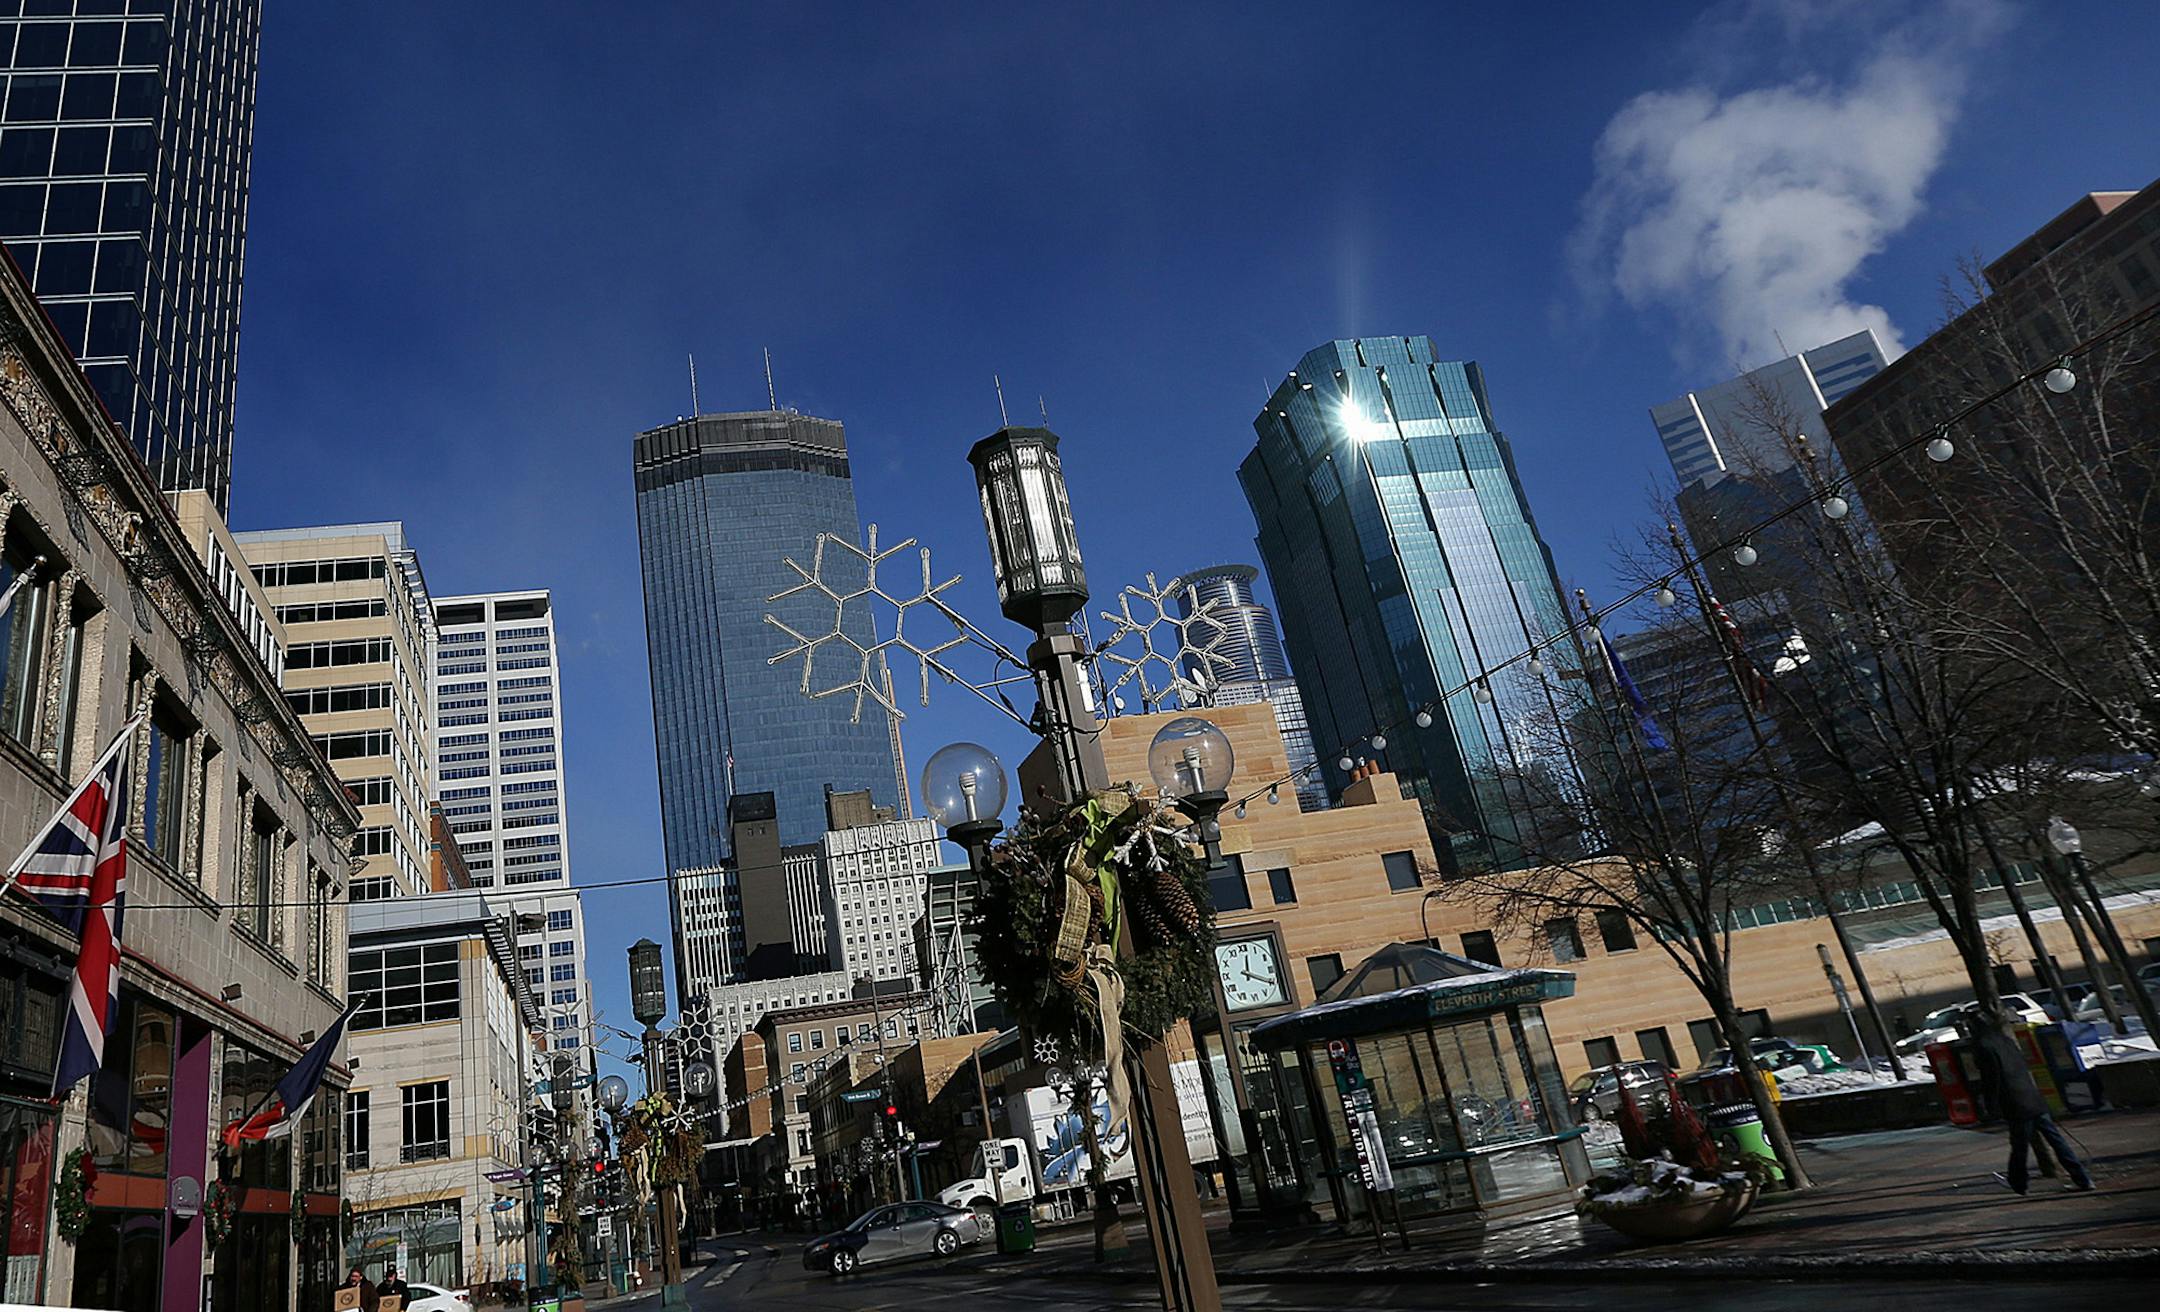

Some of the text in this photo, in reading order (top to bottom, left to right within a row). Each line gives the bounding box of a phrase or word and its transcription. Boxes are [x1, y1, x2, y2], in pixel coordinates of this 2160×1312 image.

[1228, 949, 1237, 958] XI
[1223, 960, 1230, 968] X
[1222, 972, 1231, 981] IX
[1261, 988, 1268, 997] V
[1435, 984, 1538, 1012] ELEVENTH STREET
[1182, 1111, 1208, 1121] dentity
[984, 1141, 998, 1150] ONE
[1341, 1094, 1375, 1190] FREE RIDE BUS
[985, 1149, 1000, 1157] WAY
